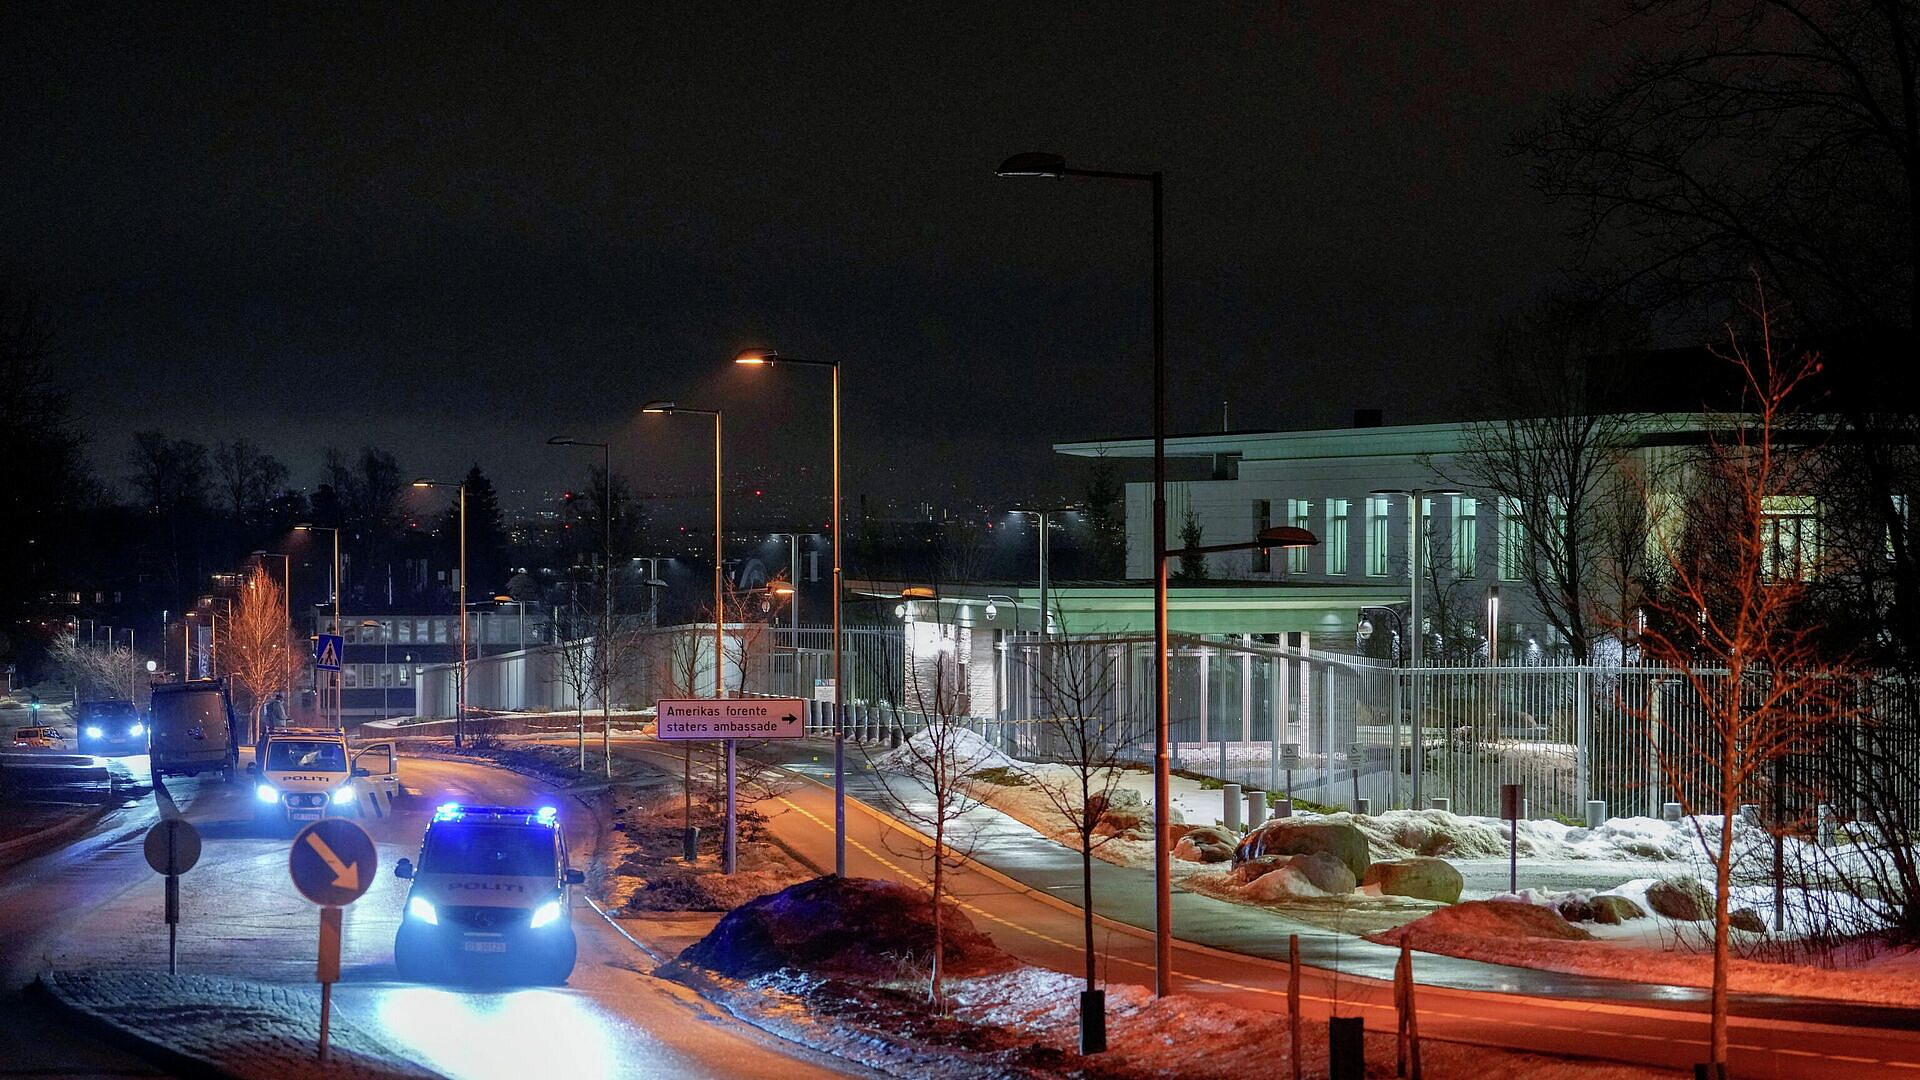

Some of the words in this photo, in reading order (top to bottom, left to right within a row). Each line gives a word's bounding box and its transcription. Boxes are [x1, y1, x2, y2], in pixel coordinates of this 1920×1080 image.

[666, 706, 720, 717] Amerikas
[726, 706, 767, 717] forente
[666, 722, 708, 732] staters
[713, 721, 778, 732] ambassade
[447, 882, 524, 893] POLITI
